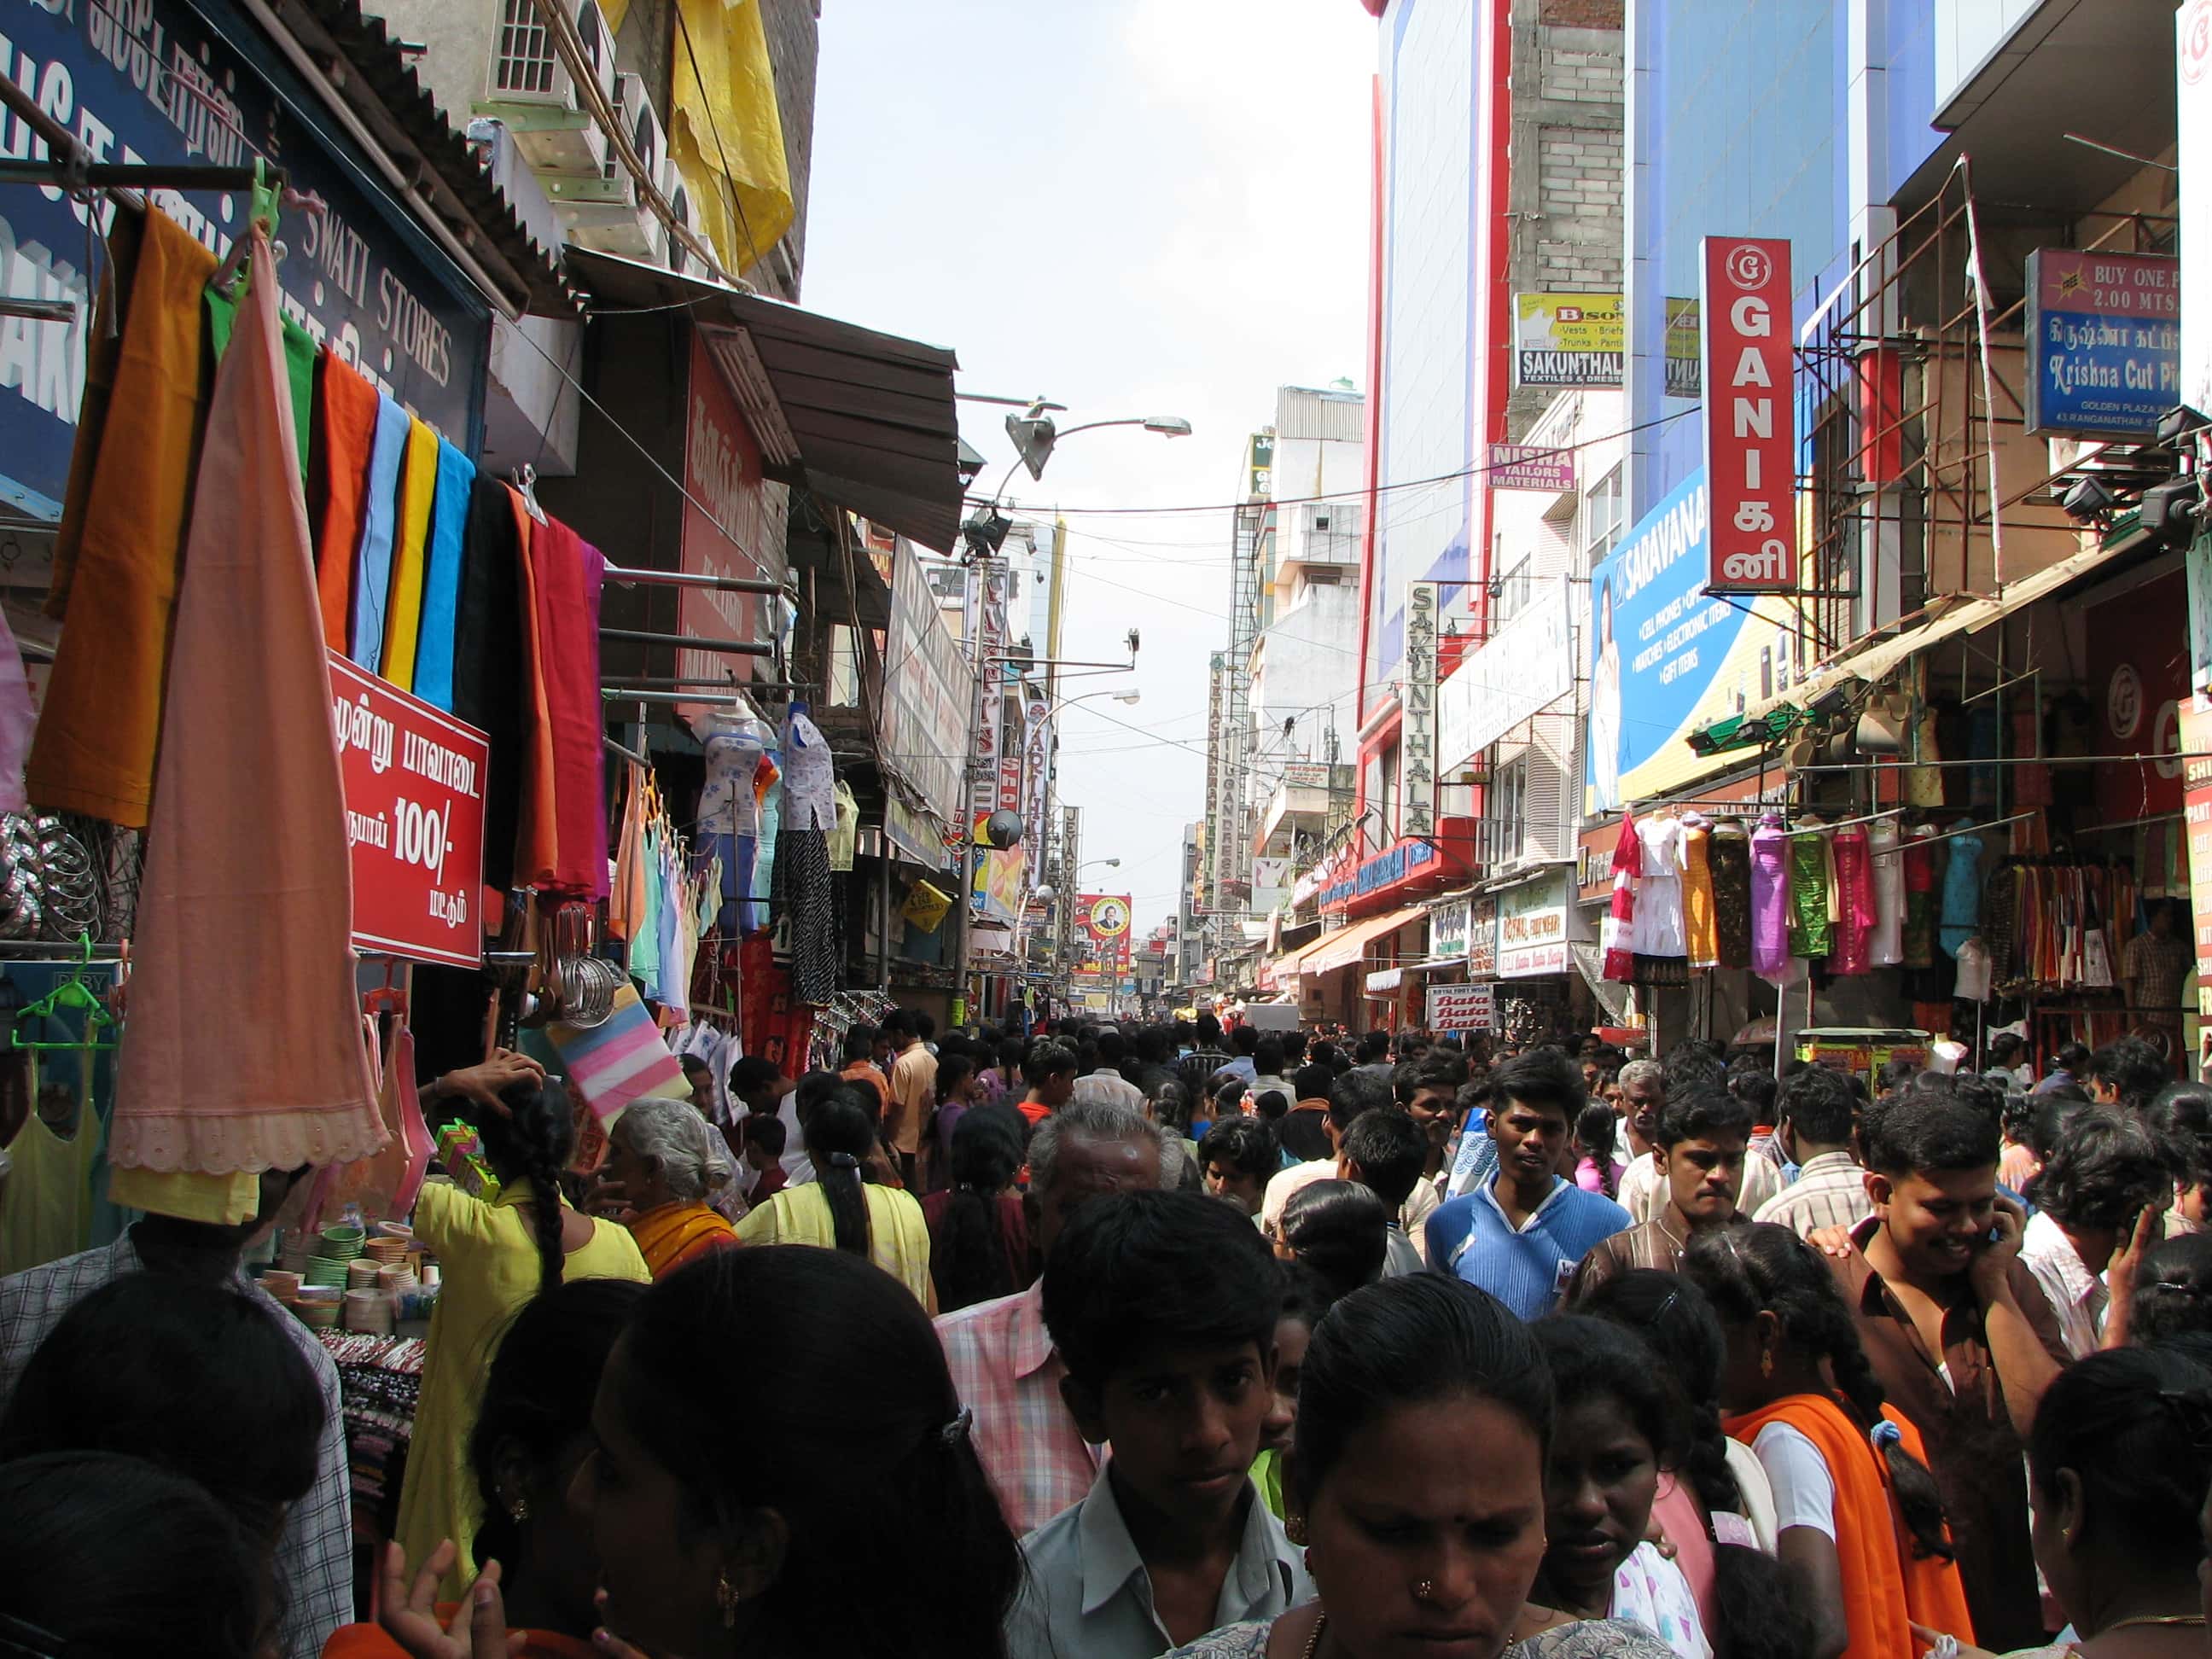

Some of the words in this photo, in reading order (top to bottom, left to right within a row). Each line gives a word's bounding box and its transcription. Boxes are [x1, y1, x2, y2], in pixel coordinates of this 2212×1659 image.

[2094, 265, 2127, 285] BUY
[301, 202, 370, 309] SWATI
[376, 266, 452, 389] STORES
[2093, 288, 2131, 309] 2.00
[1563, 338, 1592, 347] Trunks
[2049, 355, 2120, 396] Krishna
[2125, 359, 2154, 391] Cut
[1729, 295, 1775, 491] GANI
[2081, 400, 2121, 413] GOLDEN
[1493, 446, 1571, 468] NISHA
[1493, 474, 1572, 490] MATERIALS
[1505, 464, 1561, 478] TAILORS
[1625, 485, 1705, 601] SARAVANA
[1656, 596, 1683, 632] PHONES
[1667, 610, 1708, 654] ELECTRONIC
[1406, 587, 1435, 833] SAKUNTHALA
[402, 729, 480, 800] பாவாடை
[1001, 757, 1020, 810] Sho
[2186, 801, 2211, 824] PANT
[394, 796, 453, 886] 100/-
[58, 974, 107, 991] RBY
[1434, 995, 1489, 1006] Bata
[1434, 1006, 1489, 1018] Bata
[1434, 1018, 1489, 1029] Bata
